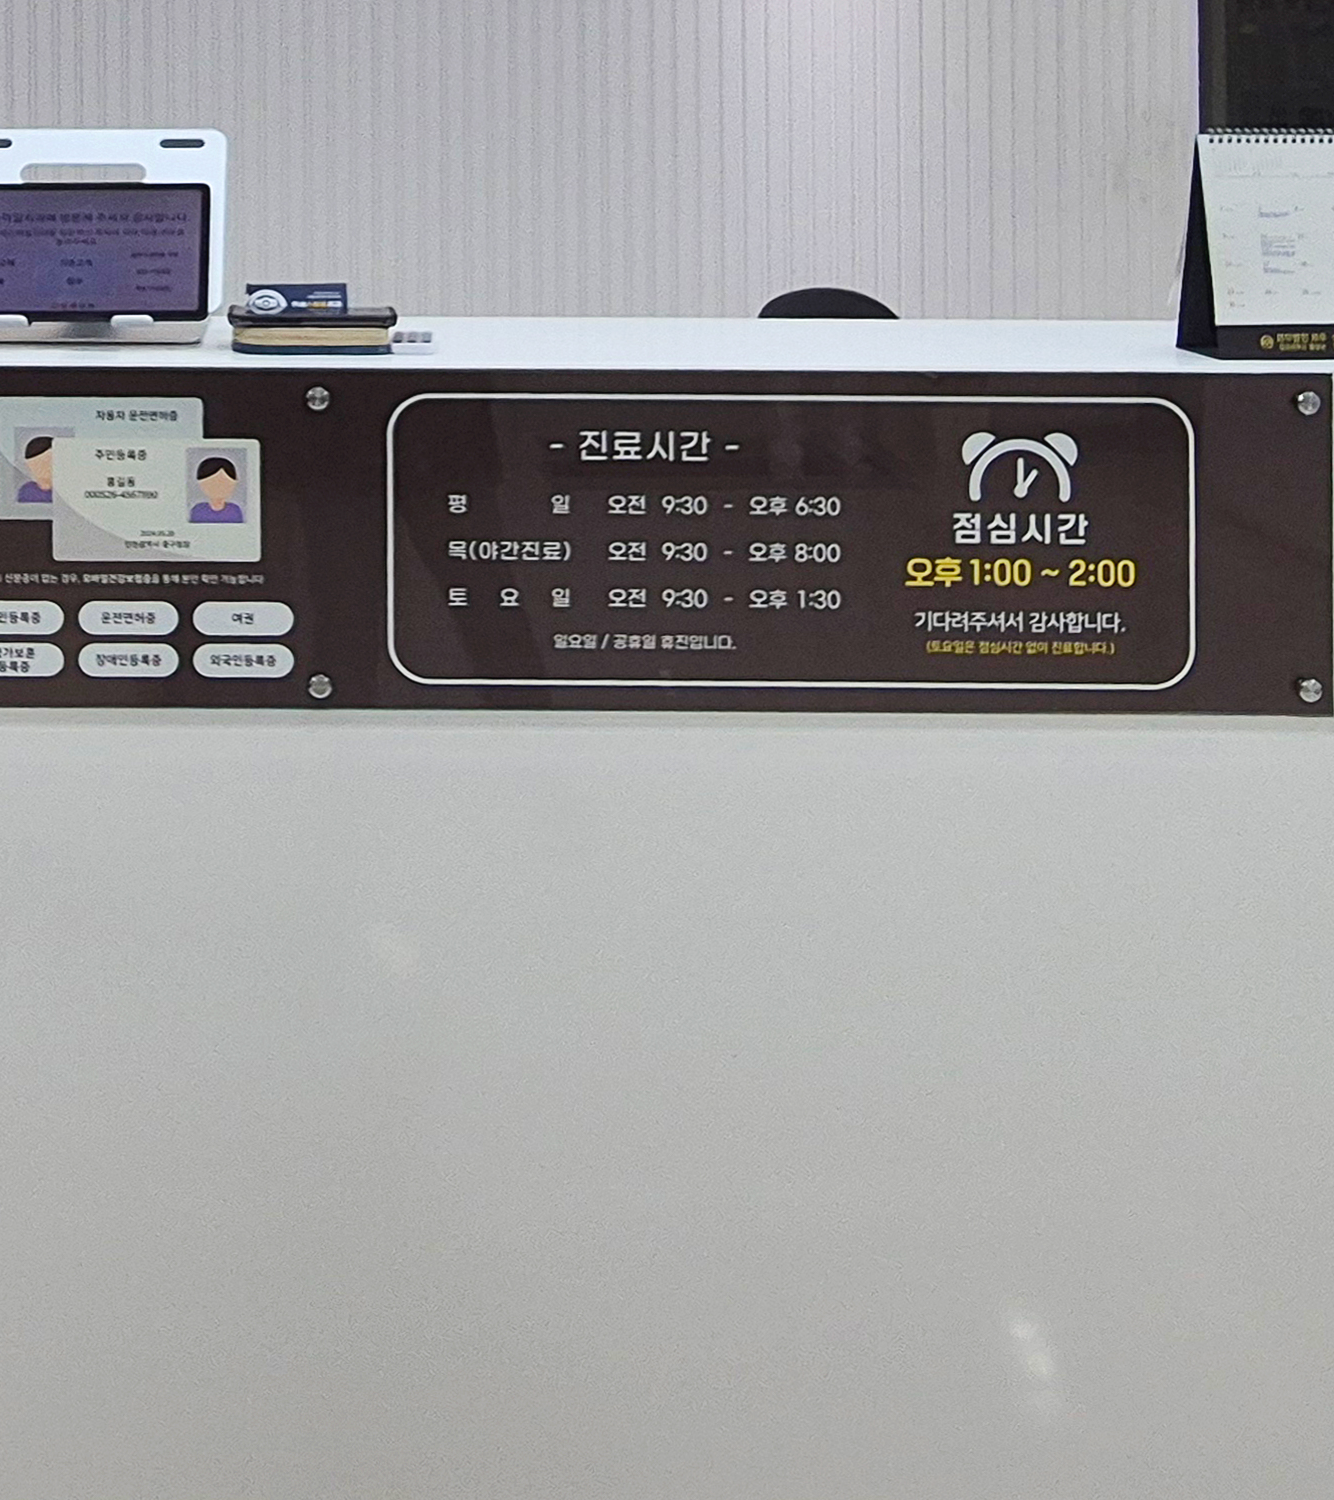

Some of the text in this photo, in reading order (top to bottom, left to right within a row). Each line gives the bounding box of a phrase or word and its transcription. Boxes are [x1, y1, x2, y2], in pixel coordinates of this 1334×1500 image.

[95, 410, 125, 421] 자동차
[579, 430, 711, 462] 진료시간
[95, 449, 147, 460] 주민등록증
[608, 495, 646, 515] 오전
[662, 496, 709, 515] 9:30
[749, 495, 788, 516] 오후
[795, 496, 841, 516] 6:30
[952, 512, 1089, 546] 점심시간
[448, 541, 572, 563] 목(야간진료)
[608, 542, 646, 563] 오전
[662, 543, 709, 563] 9:30
[749, 542, 788, 563] 오후
[795, 543, 841, 563] 8:00
[905, 557, 962, 588] 오후
[970, 558, 1032, 587] 1:00
[1068, 559, 1136, 587] 2:00
[608, 589, 646, 609] 오전
[662, 590, 709, 609] 9:30
[749, 589, 788, 610] 오후
[795, 590, 841, 610] 1:30
[100, 612, 156, 624] 운전면허증
[231, 612, 255, 625] 여권
[914, 610, 1127, 633] 기다려주셔서 감사합니다.
[554, 634, 598, 650] 일요일
[613, 634, 656, 650] 공휴일
[661, 634, 737, 650] 휴진입니다.
[1026, 640, 1049, 655] 없이
[95, 654, 162, 667] 장애인등록증
[210, 654, 277, 668] 외국인등록증
